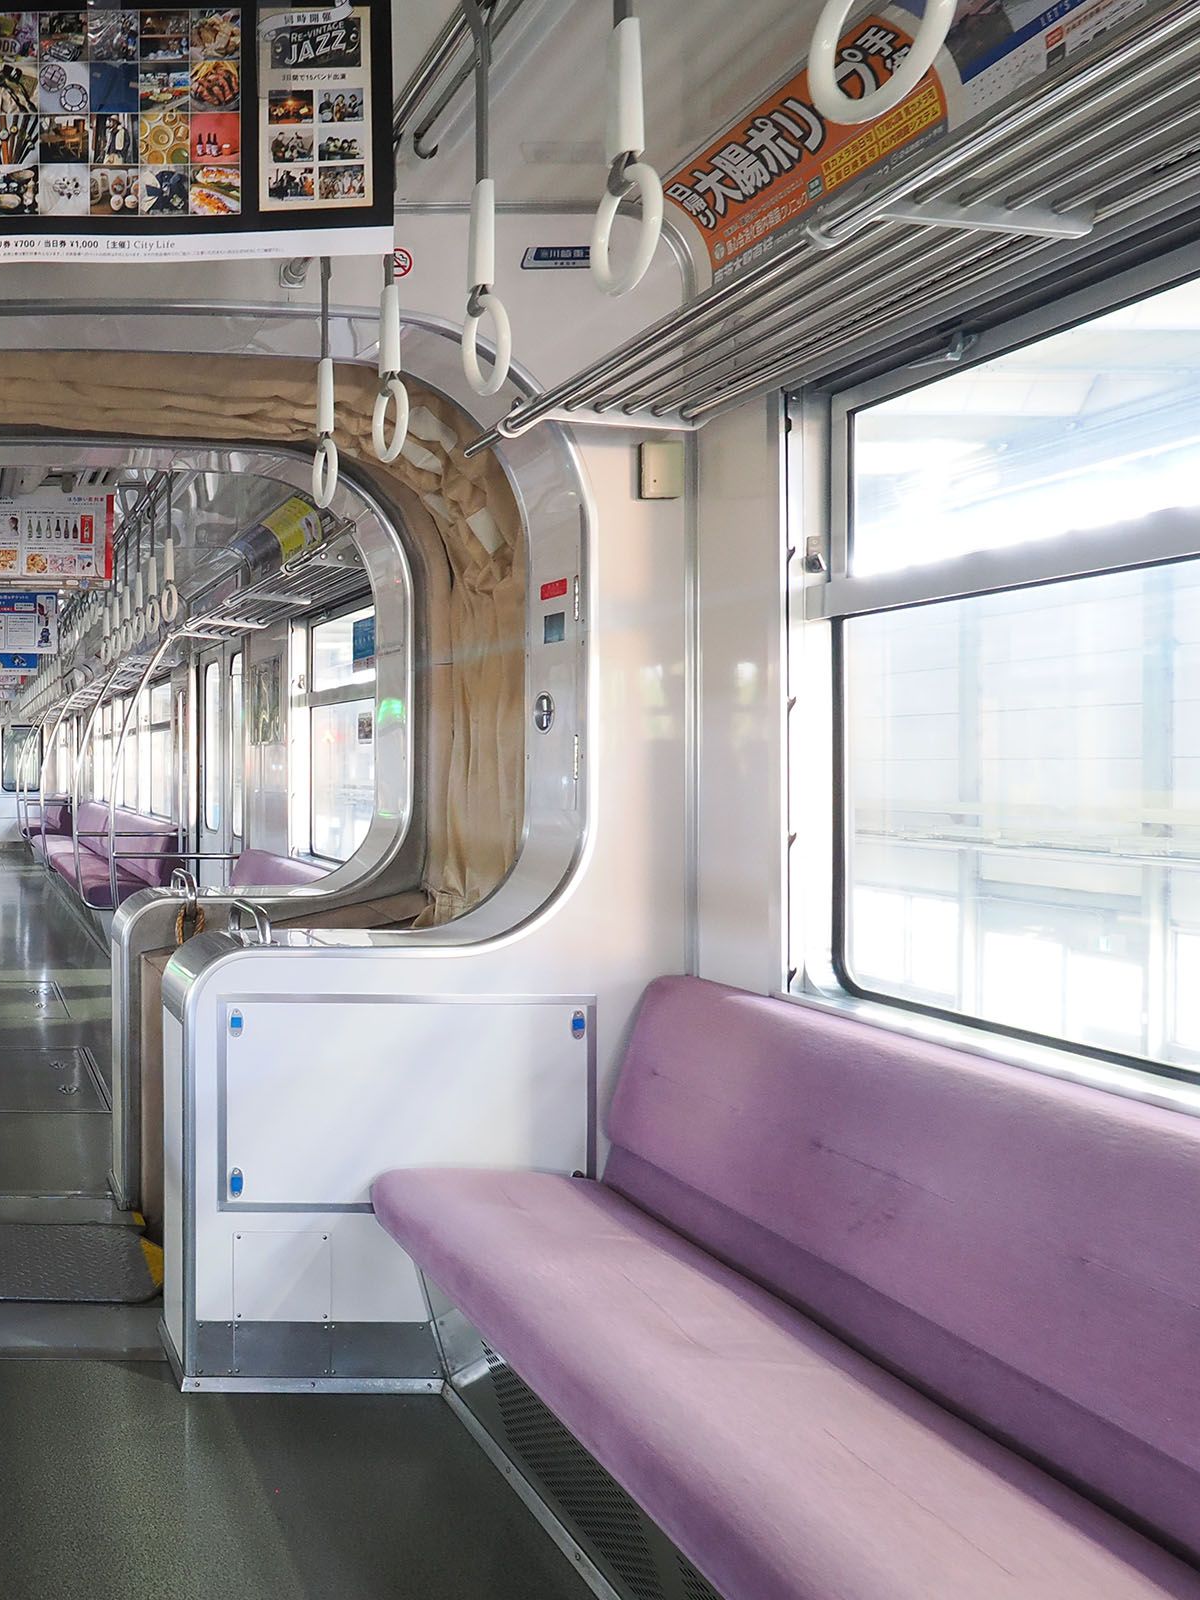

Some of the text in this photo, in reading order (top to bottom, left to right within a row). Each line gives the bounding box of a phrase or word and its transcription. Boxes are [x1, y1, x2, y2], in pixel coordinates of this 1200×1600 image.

[284, 11, 332, 25] 同時開催
[290, 21, 345, 43] RE-VINTAGE
[284, 29, 347, 65] JAZZ
[14, 240, 35, 249] ¥700
[44, 239, 67, 249] 当日券
[70, 240, 99, 250] ¥1,000
[134, 240, 154, 252] City
[156, 240, 176, 250] Life
